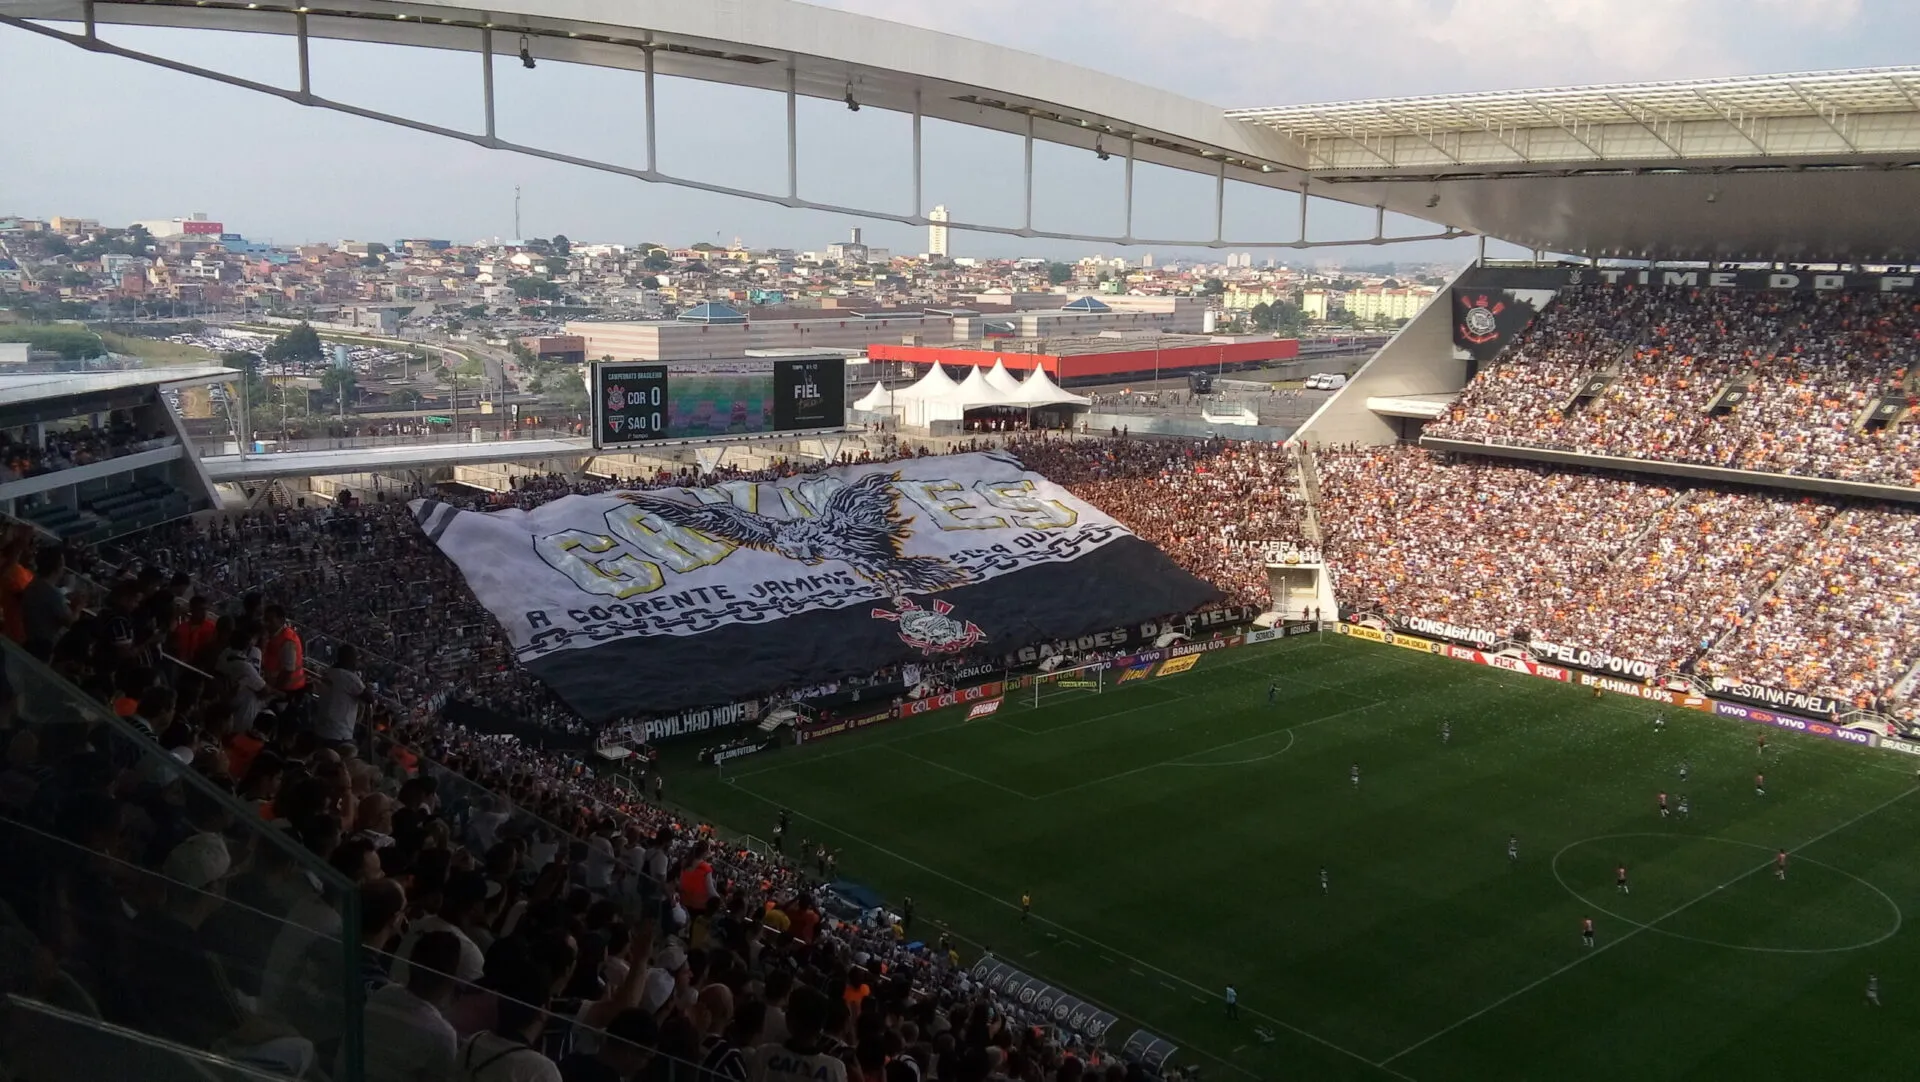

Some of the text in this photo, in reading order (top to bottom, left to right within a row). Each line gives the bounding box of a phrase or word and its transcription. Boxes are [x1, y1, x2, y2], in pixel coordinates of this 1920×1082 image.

[1600, 270, 1737, 287] TIME
[1769, 273, 1844, 290] DO
[627, 386, 660, 406] COR 0
[794, 384, 820, 398] FIEL
[627, 412, 660, 431] SAO 0
[527, 609, 552, 629] A
[567, 584, 736, 623] CORRENTE
[748, 569, 855, 599] JAMAIS
[1184, 607, 1239, 630] FIEL
[1290, 624, 1311, 635] IGUAIS
[1255, 630, 1275, 641] SOMOS
[1352, 628, 1366, 636] BOA
[1366, 630, 1382, 640] IDEIA
[1397, 637, 1411, 646] BOA
[1411, 640, 1428, 650] IDEIA
[1409, 616, 1496, 646] CONSAGRADO
[1172, 642, 1207, 657] BRAHMA
[1547, 641, 1591, 666] PELO
[1452, 647, 1562, 680] FISK FISK FISK
[911, 686, 985, 715] GOL GOL GOL
[1581, 674, 1640, 697] BRAHMA
[1643, 688, 1673, 704] 0.0%
[713, 702, 745, 728] NOVE
[767, 1054, 829, 1081] CAIXA
